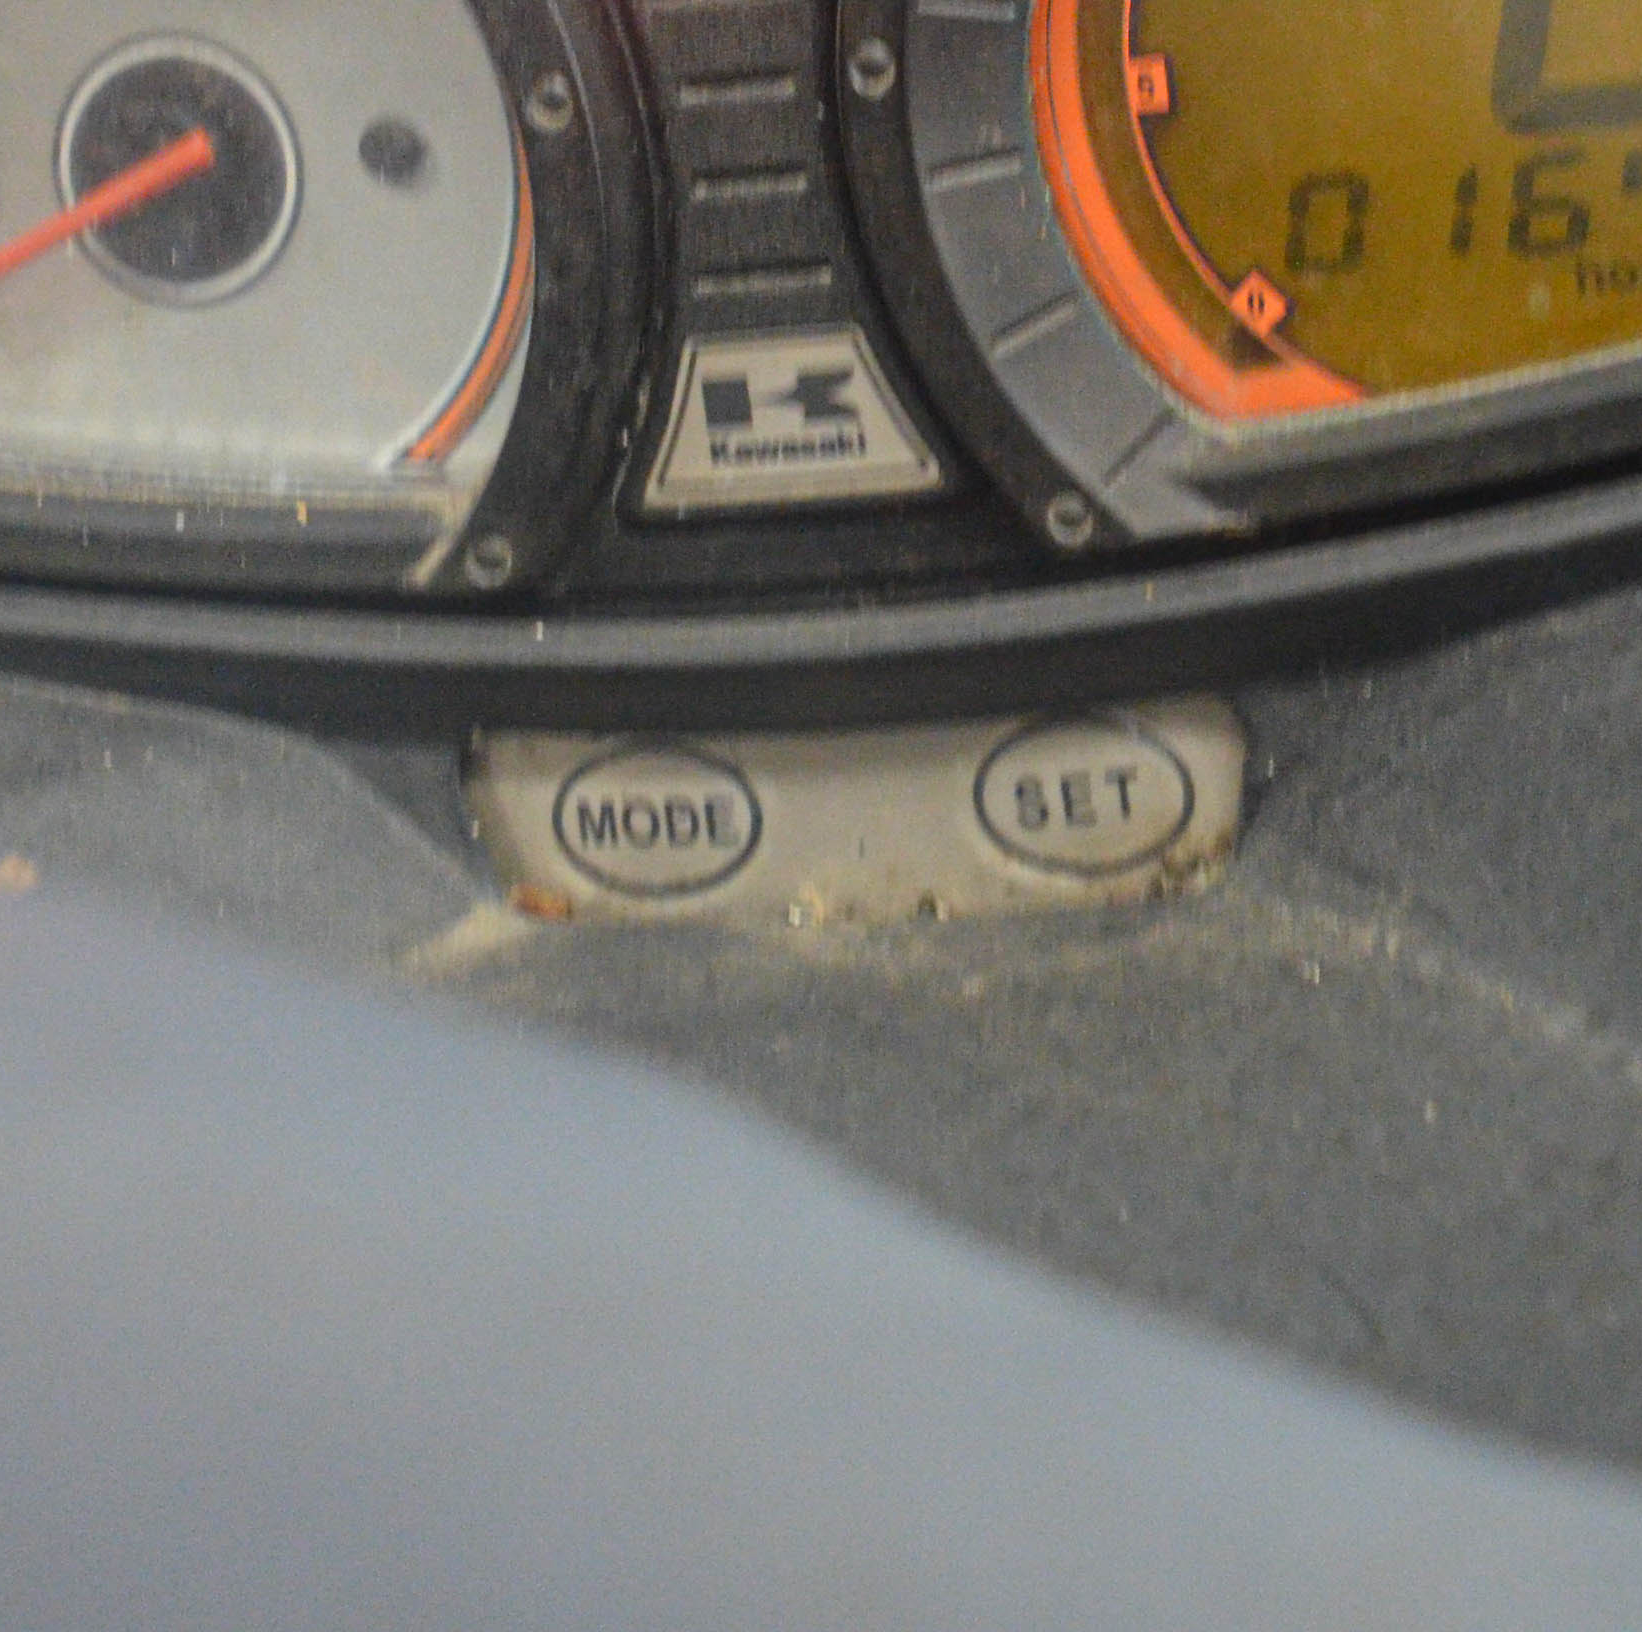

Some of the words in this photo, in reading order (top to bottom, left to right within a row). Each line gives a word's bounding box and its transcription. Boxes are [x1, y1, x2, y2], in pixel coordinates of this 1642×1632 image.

[709, 429, 867, 466] Kawasaki
[575, 792, 741, 851] MODE
[1013, 768, 1140, 833] SET
